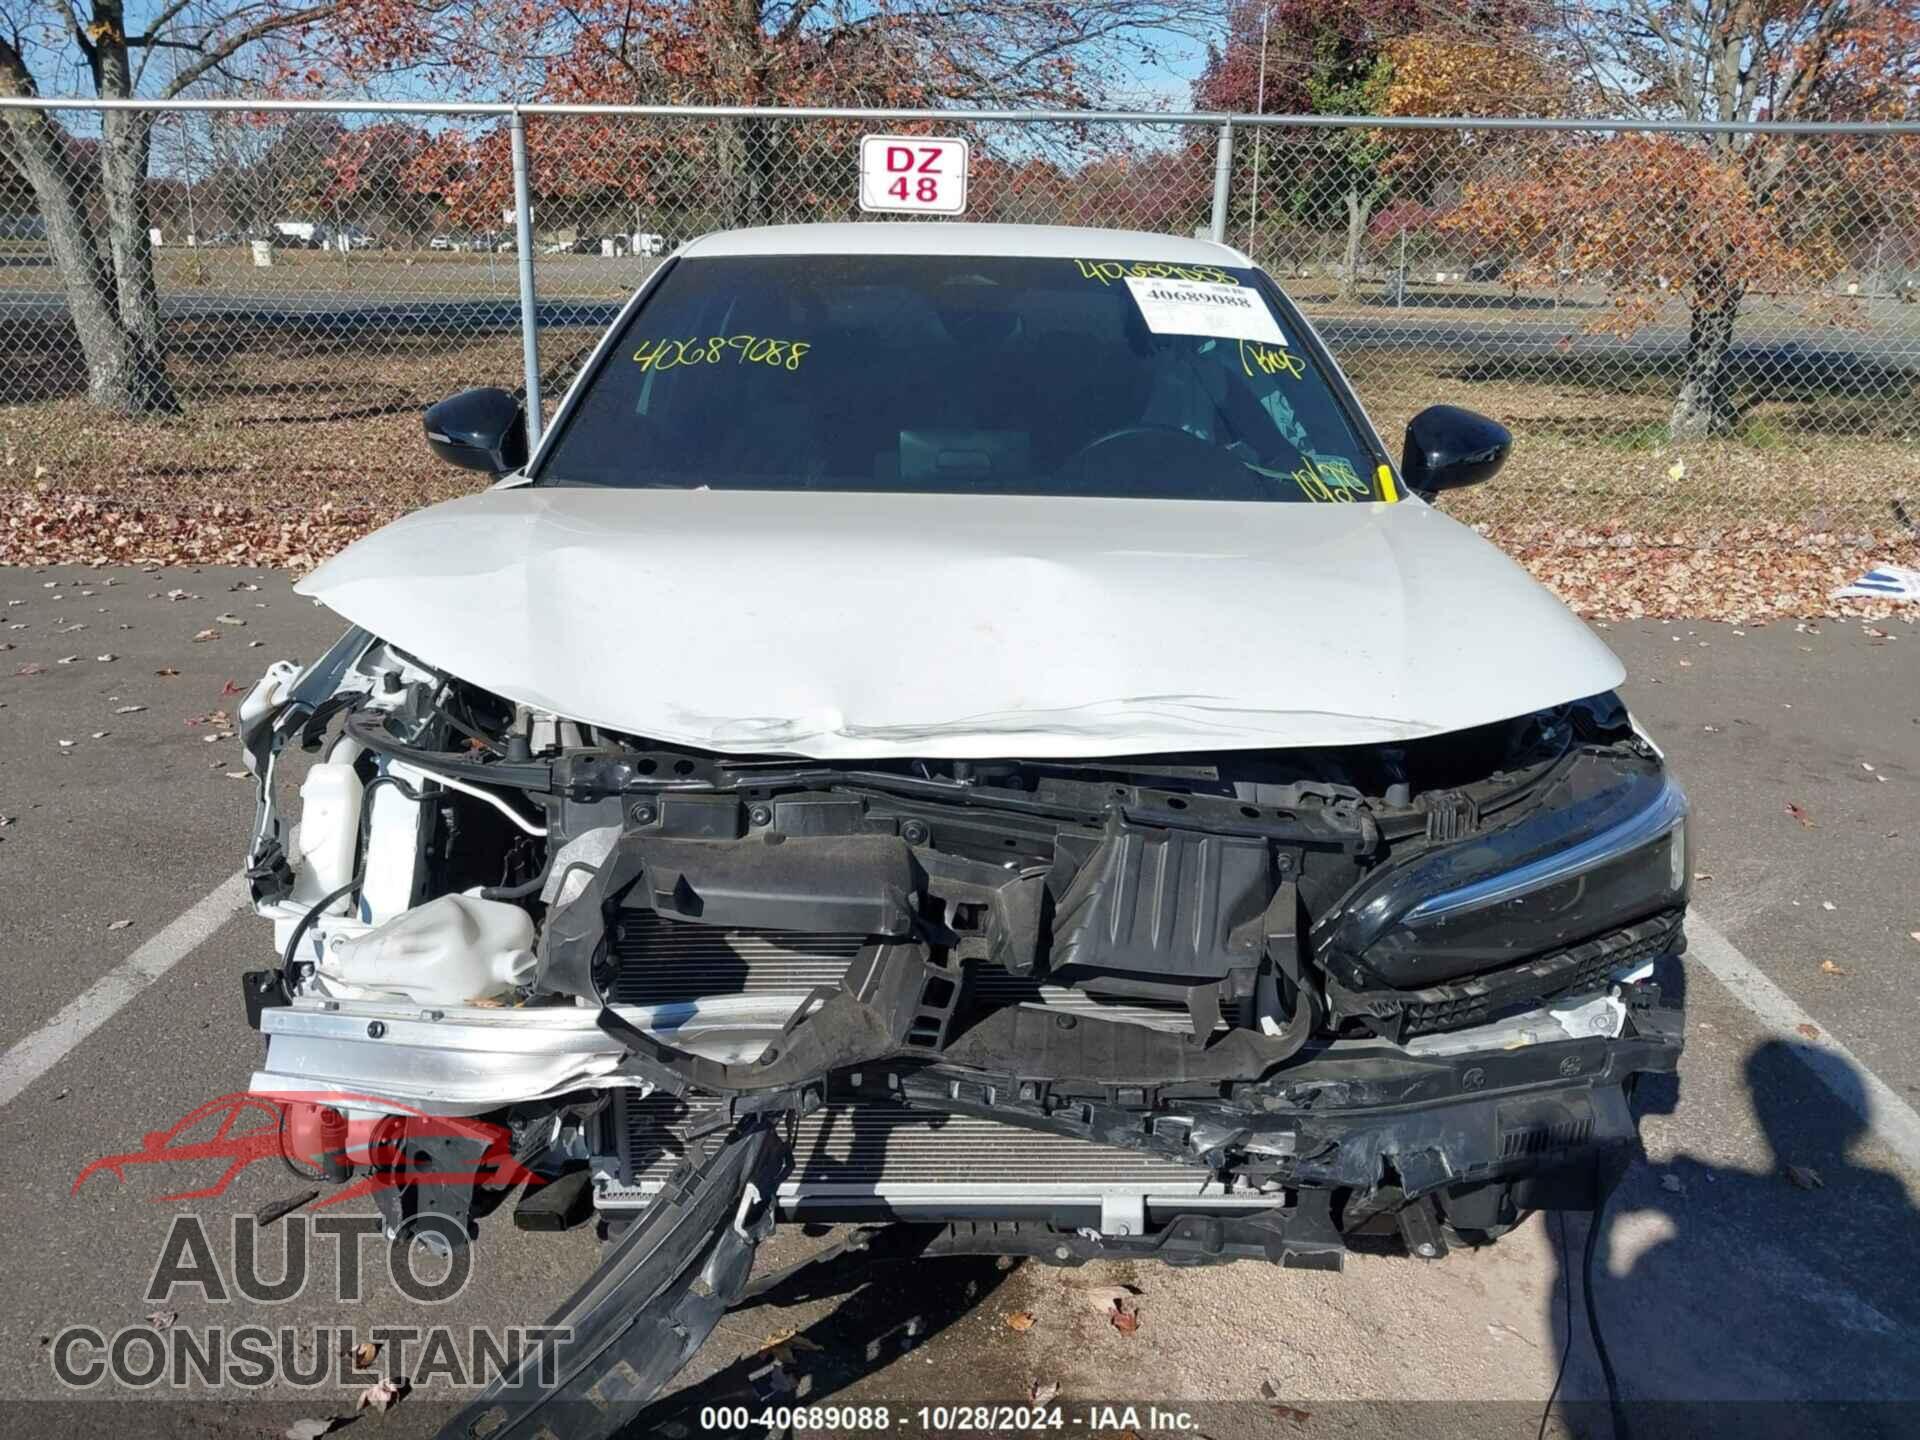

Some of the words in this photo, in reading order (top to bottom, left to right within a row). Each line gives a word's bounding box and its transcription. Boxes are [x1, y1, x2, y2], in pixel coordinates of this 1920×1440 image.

[887, 147, 943, 174] DZ
[888, 176, 938, 202] 48
[1147, 289, 1252, 309] 40689088
[633, 335, 811, 372] 40689088
